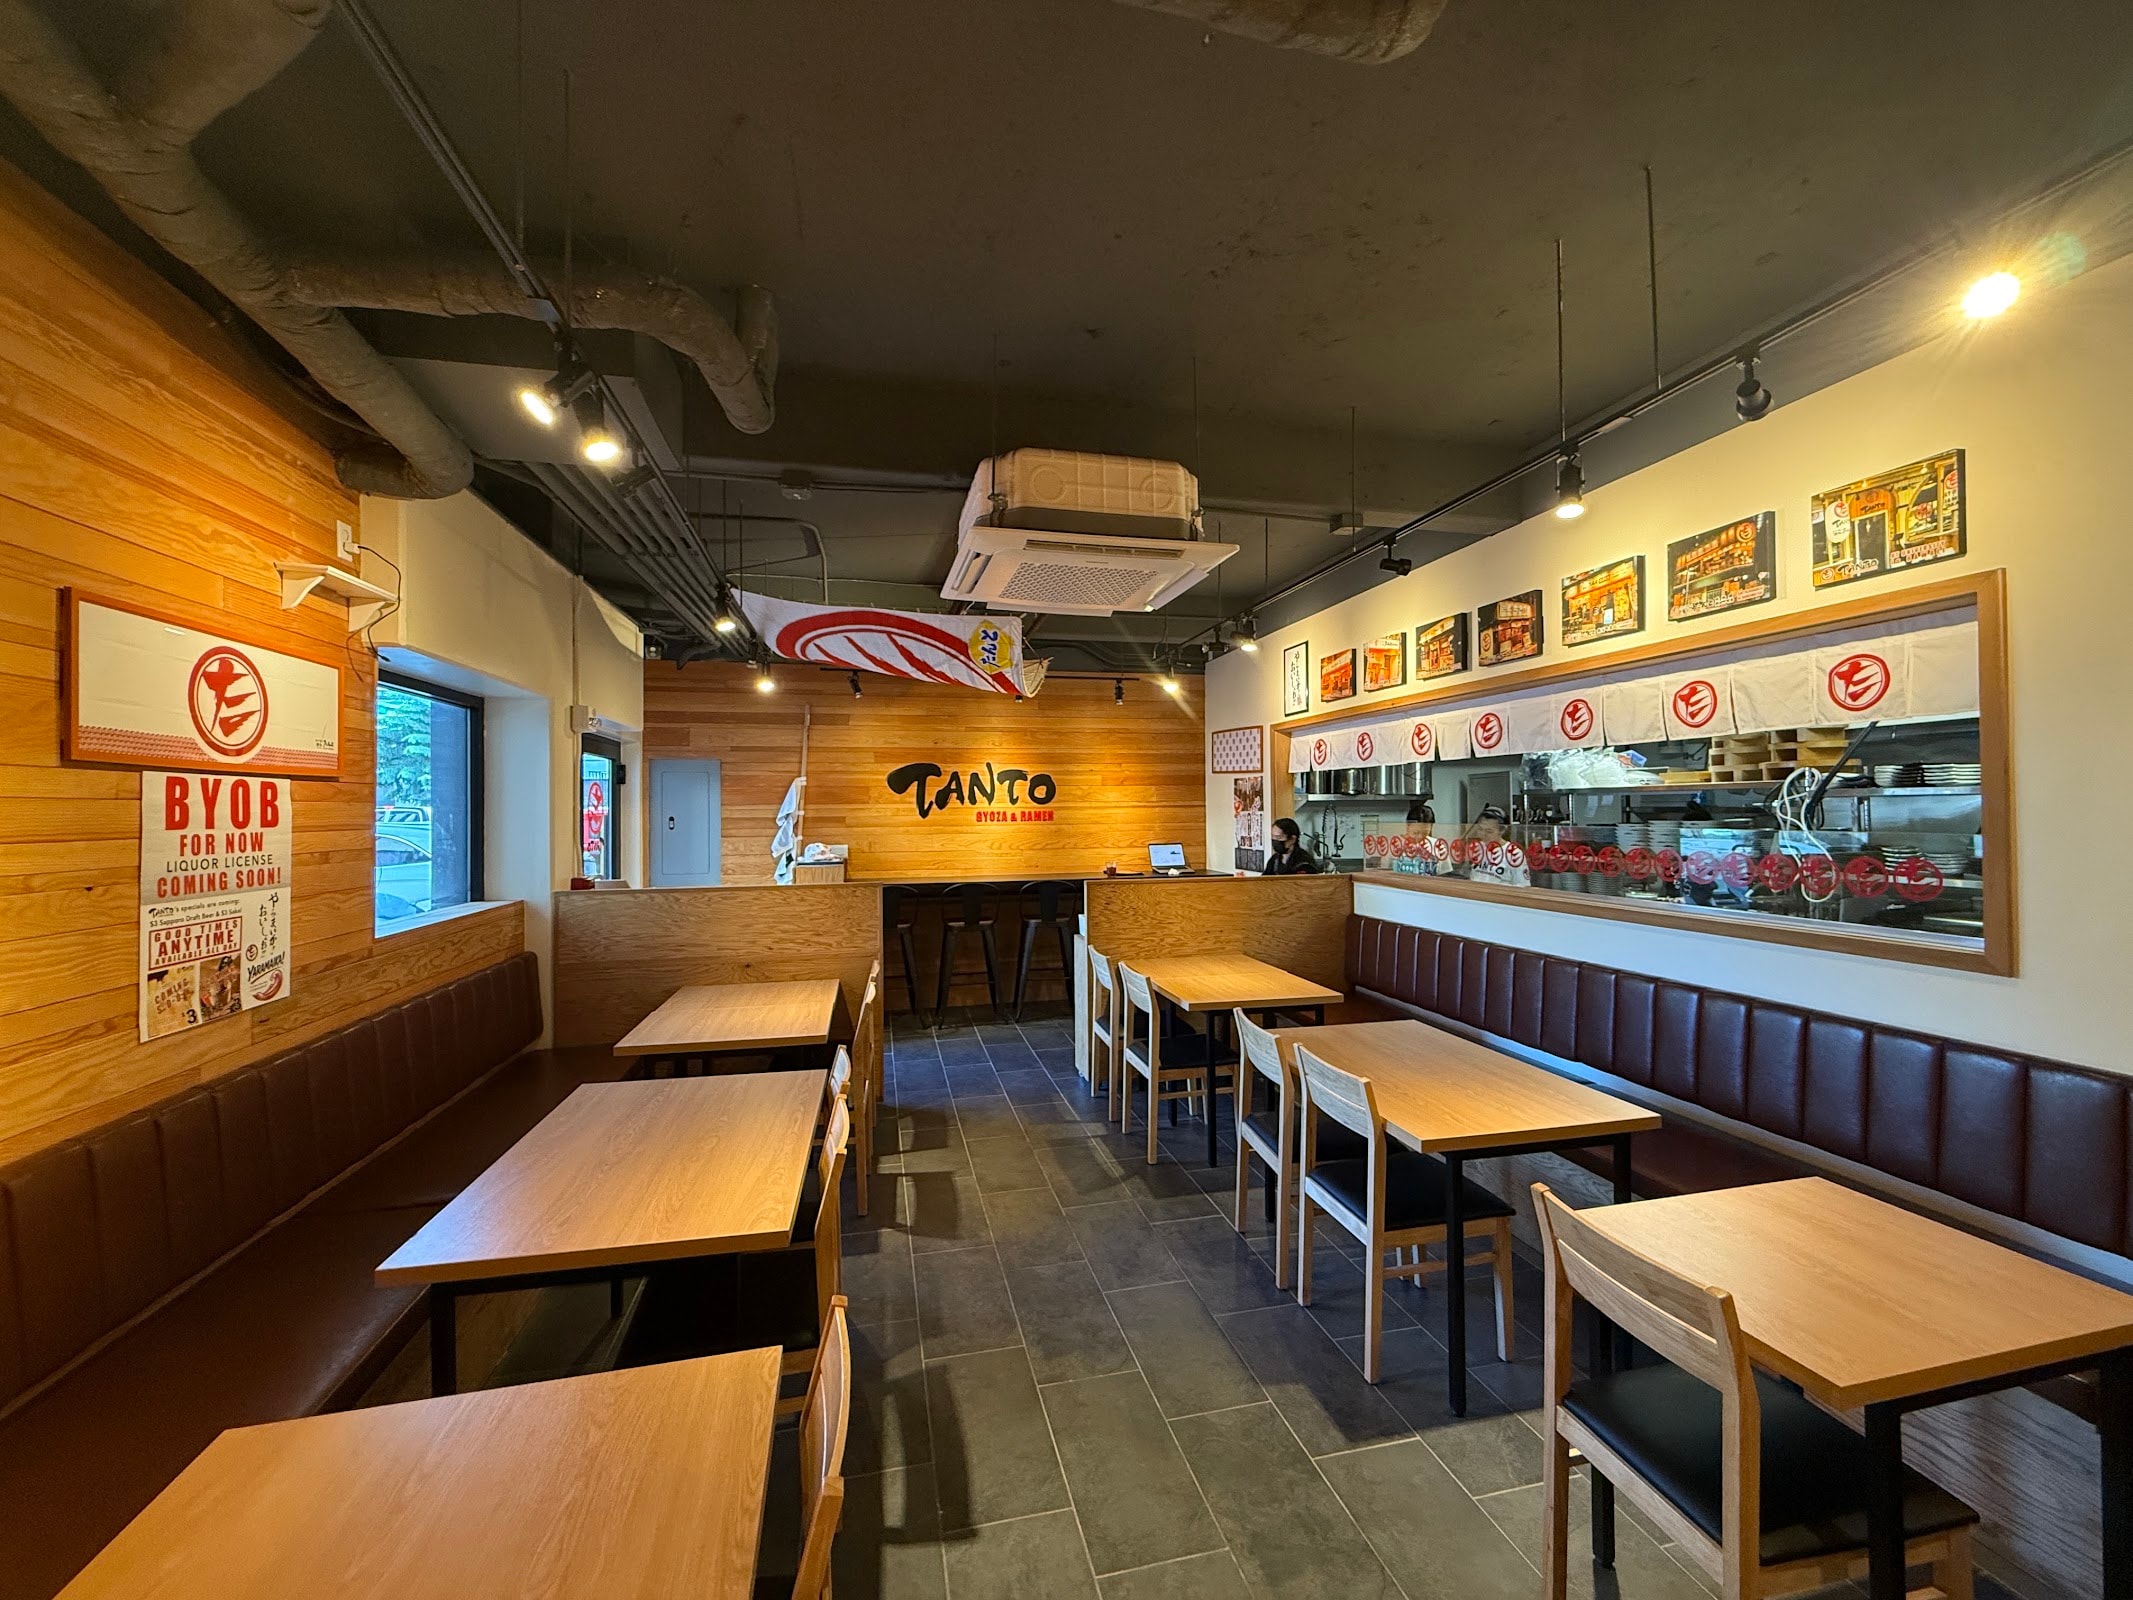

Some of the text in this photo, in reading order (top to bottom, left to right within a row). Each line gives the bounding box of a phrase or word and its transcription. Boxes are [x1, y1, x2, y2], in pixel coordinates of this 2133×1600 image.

[165, 776, 279, 830] BYOB
[887, 762, 1057, 819] TANTO
[976, 810, 1054, 822] GYOZA & RAMEN
[180, 832, 263, 856] FOR NOW
[167, 854, 273, 873] LIQUOR LICENSE
[157, 867, 281, 898] COMING SOON!
[155, 919, 238, 942] GOOD TIMES
[158, 929, 234, 957] ANYTIME
[155, 942, 238, 966] AVAILABLE ALL DAY
[247, 951, 285, 982] YARAMAIKA!
